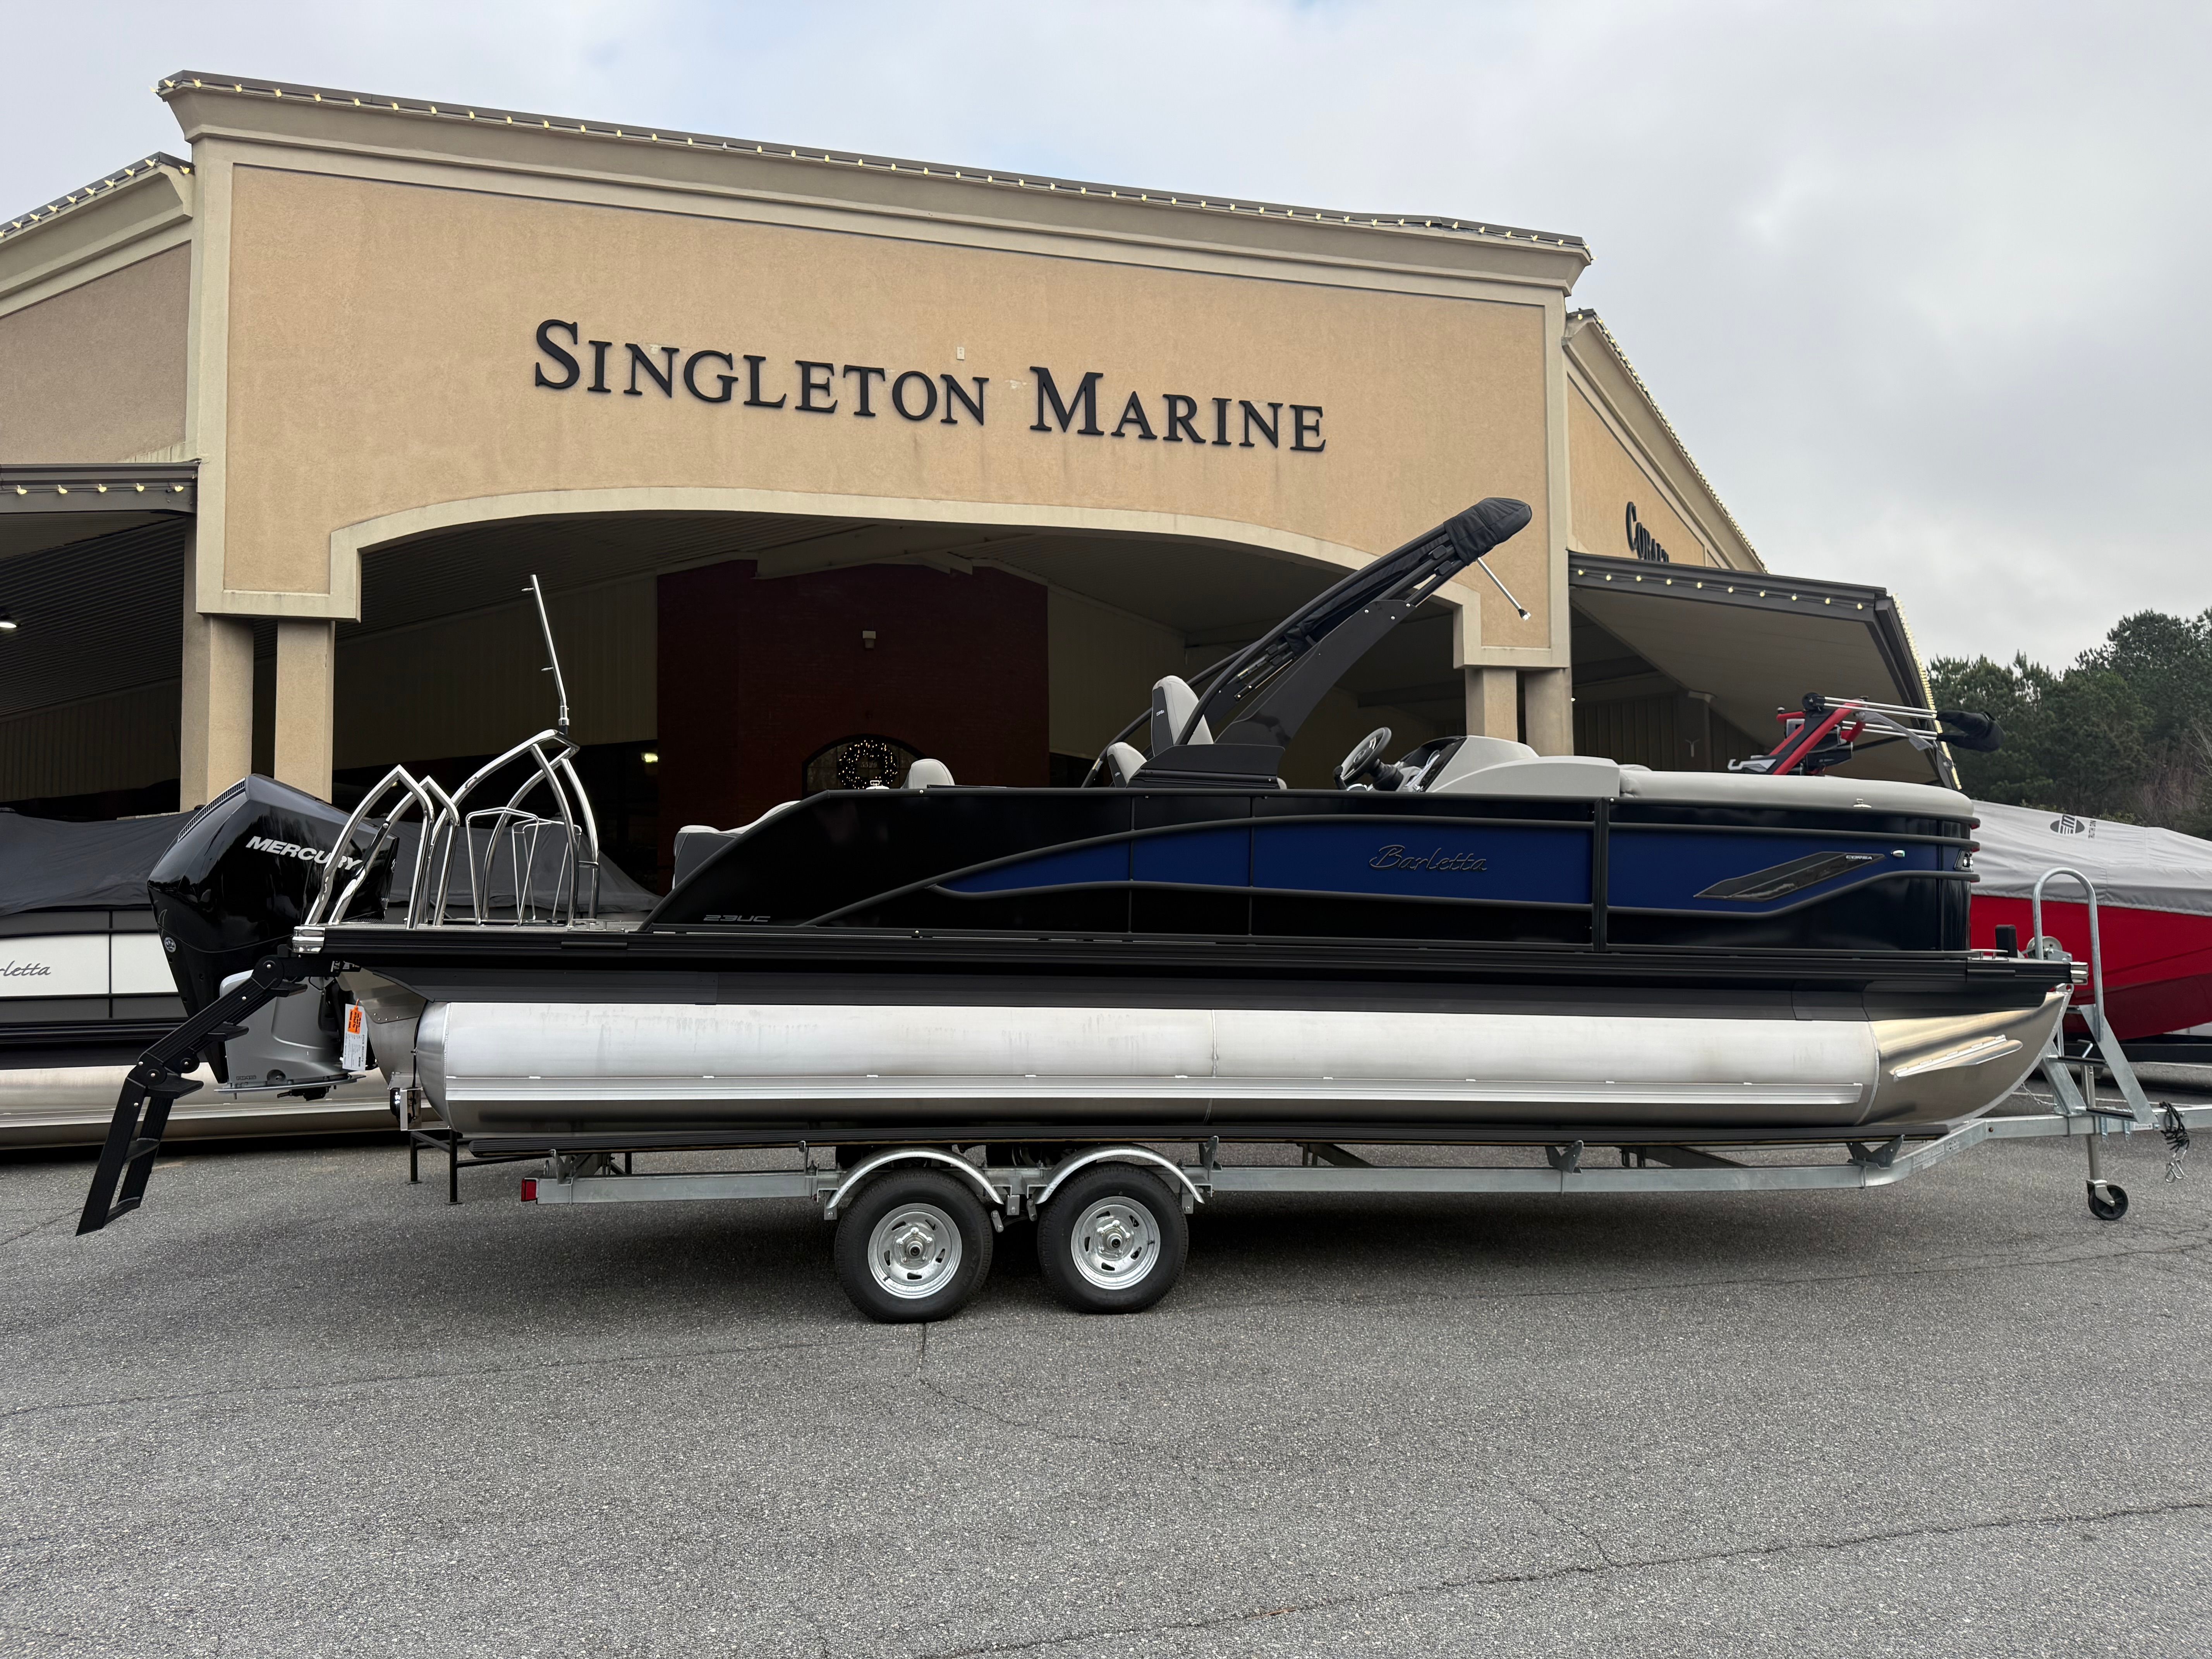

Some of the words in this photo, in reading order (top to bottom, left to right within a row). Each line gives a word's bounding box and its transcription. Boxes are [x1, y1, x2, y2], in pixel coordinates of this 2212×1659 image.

[535, 319, 989, 426] SINGLETON
[1029, 366, 1326, 452] MARINE
[1369, 844, 1487, 871] Barletta
